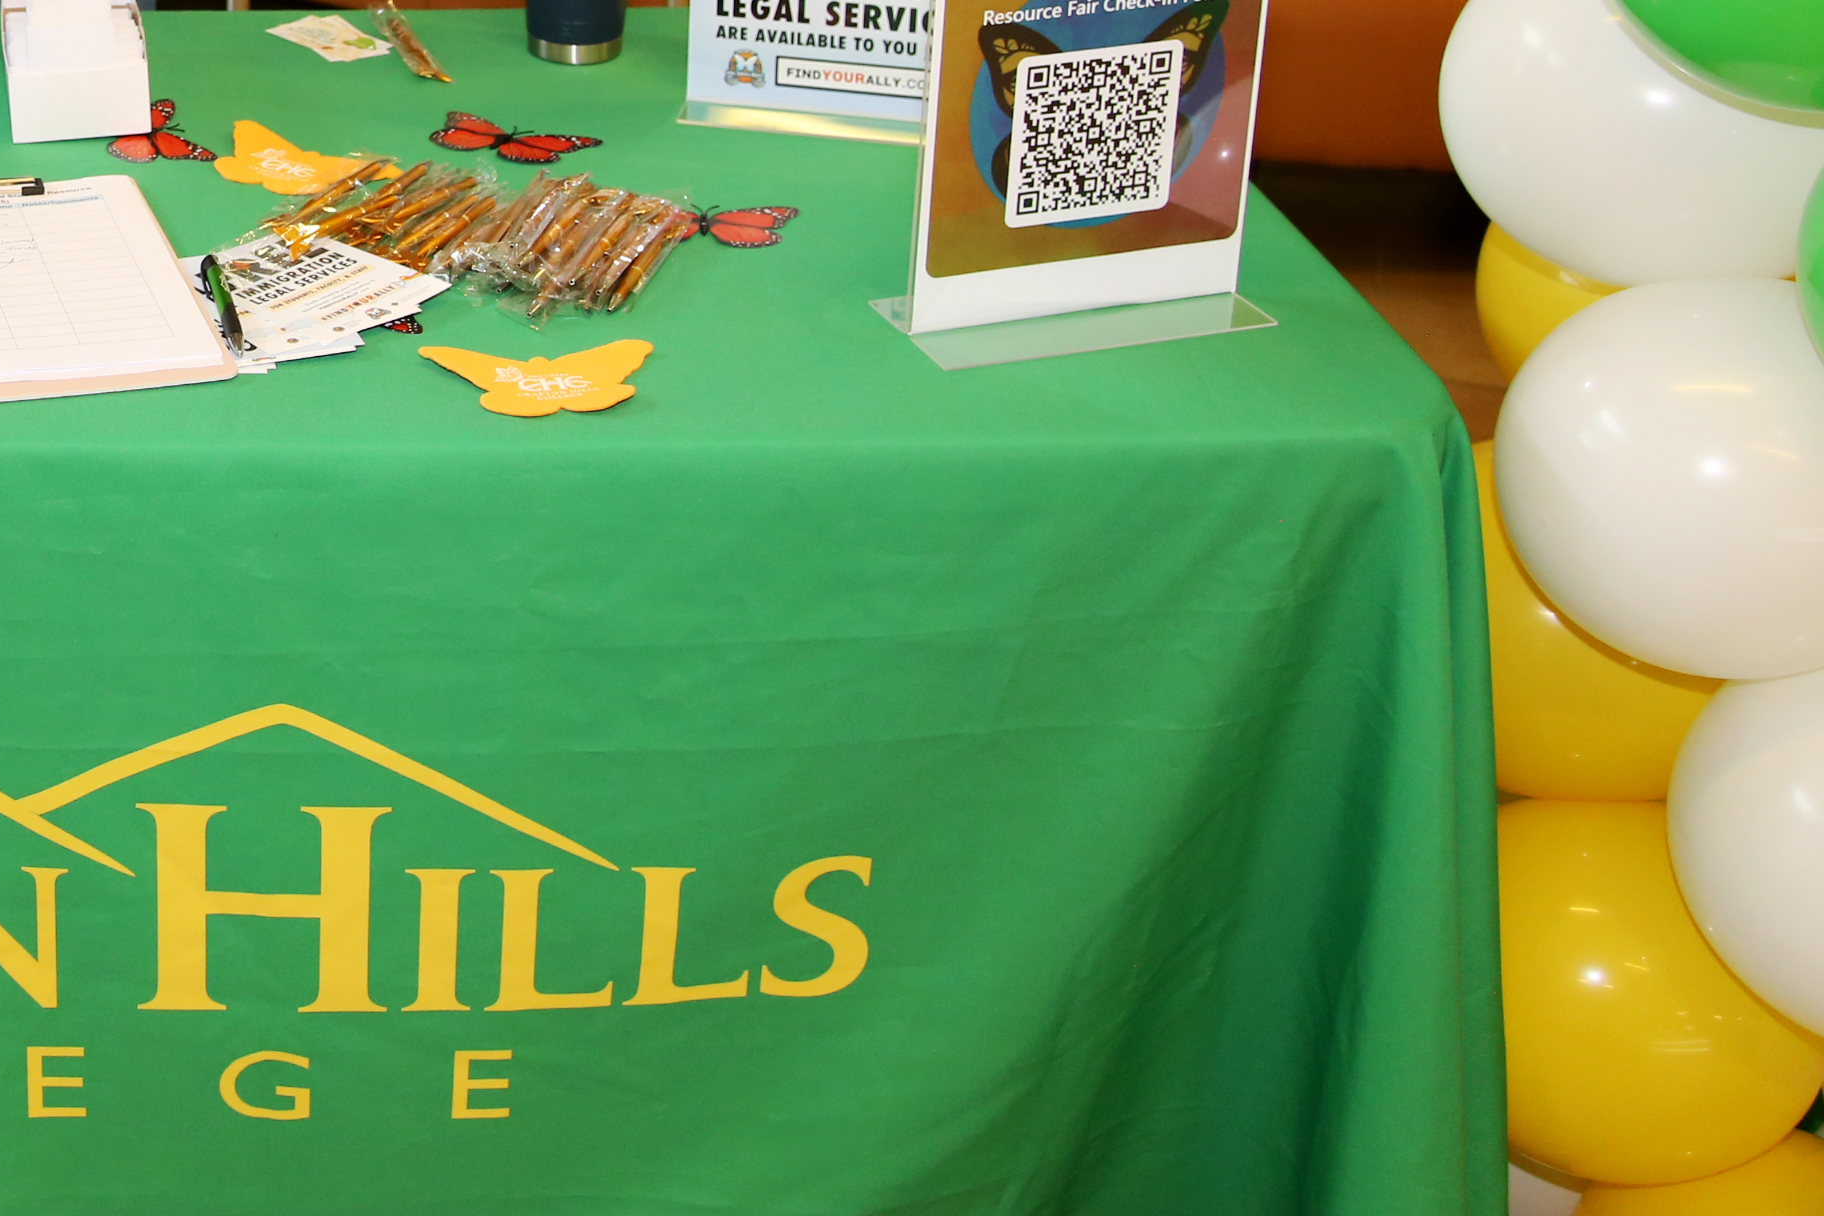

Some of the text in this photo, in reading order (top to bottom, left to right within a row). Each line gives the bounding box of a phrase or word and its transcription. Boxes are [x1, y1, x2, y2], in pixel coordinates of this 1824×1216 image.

[982, 4, 1062, 27] Resource
[716, 25, 749, 41] ARE
[755, 28, 847, 50] AVAILABLE
[854, 37, 875, 52] TO
[883, 40, 918, 56] YOU
[786, 66, 925, 90] FINDYOURALLY.CO
[236, 251, 345, 299] IMMIGRATION
[249, 284, 296, 306] LEGAL
[294, 257, 358, 288] SERVICES
[135, 802, 874, 1014] HILLS
